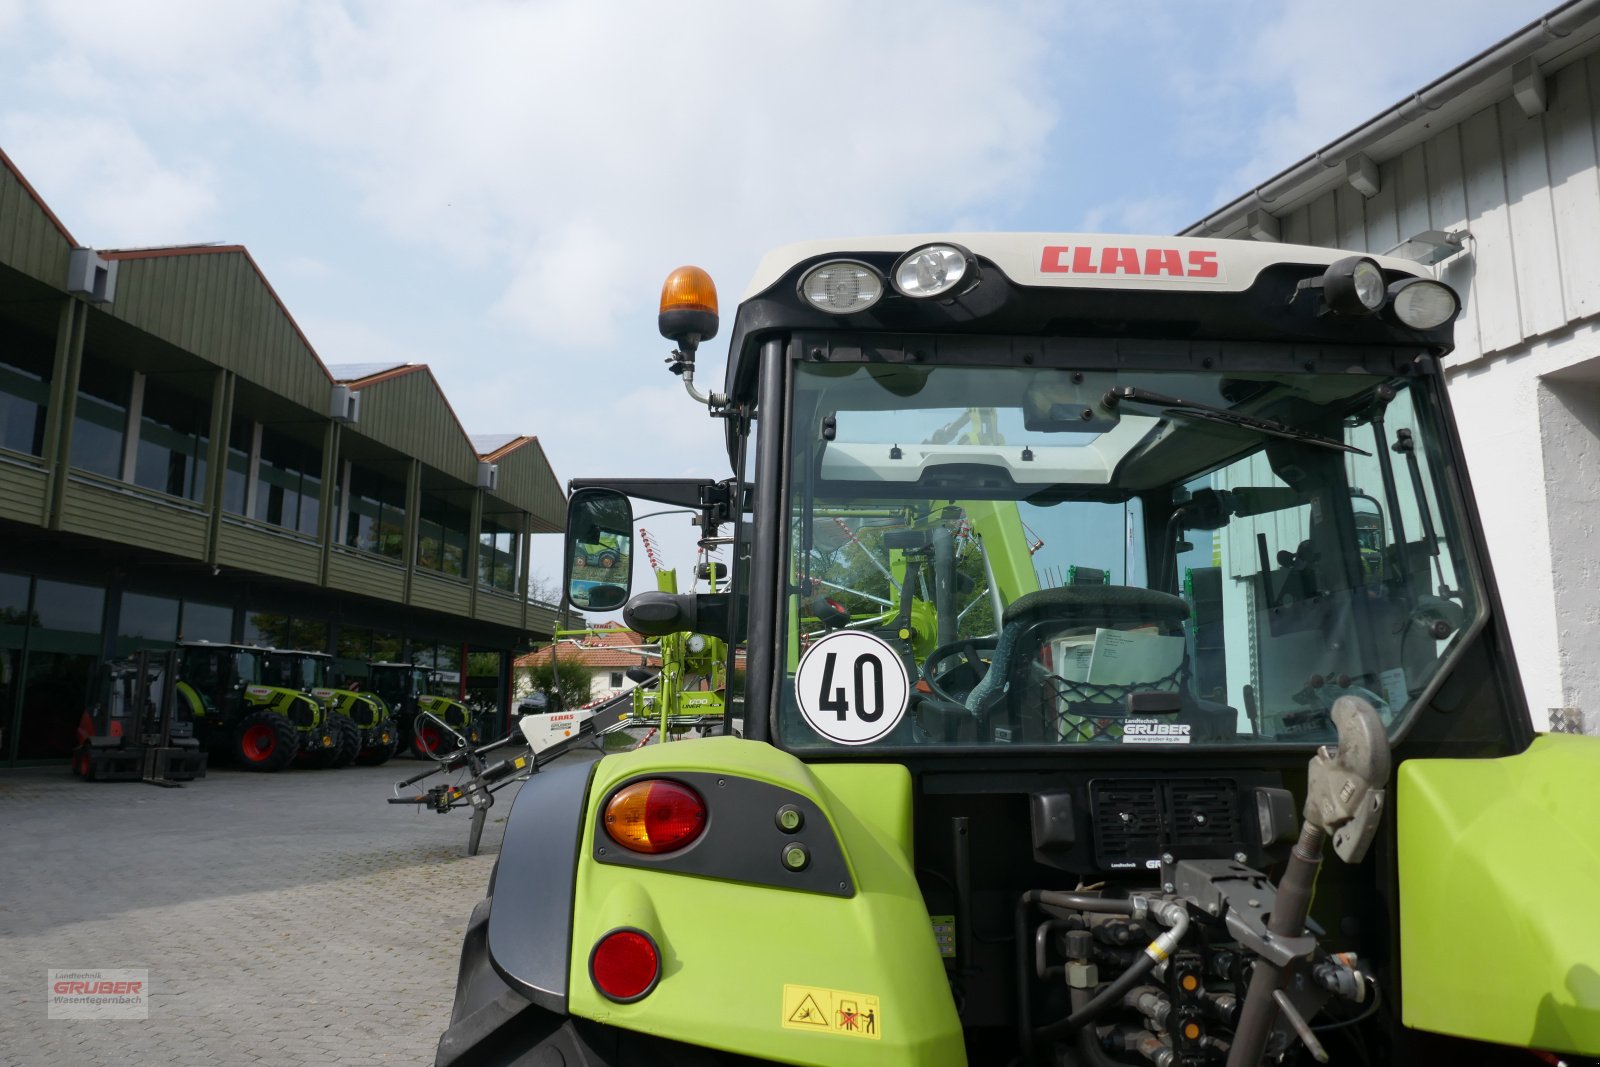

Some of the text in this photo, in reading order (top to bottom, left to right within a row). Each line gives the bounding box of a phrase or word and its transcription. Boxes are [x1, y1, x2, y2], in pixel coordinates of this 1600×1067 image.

[1040, 245, 1218, 278] CLAAS
[818, 652, 885, 723] 40
[1123, 724, 1191, 735] GRUBER
